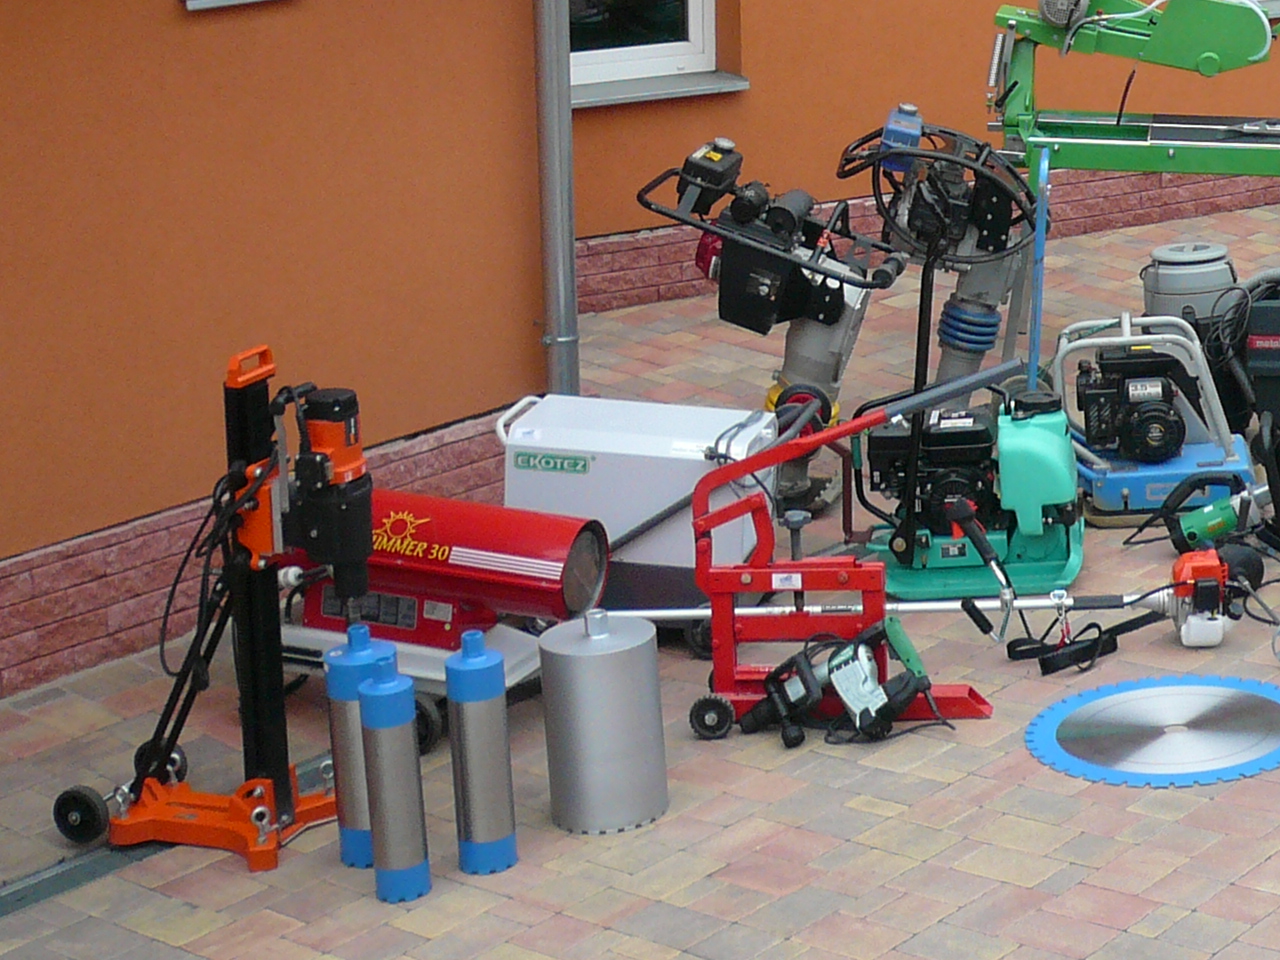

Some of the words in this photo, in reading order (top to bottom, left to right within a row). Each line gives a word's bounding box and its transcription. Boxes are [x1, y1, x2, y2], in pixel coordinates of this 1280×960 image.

[517, 453, 587, 471] EKOTEZ
[372, 533, 428, 558] IMMER
[427, 543, 450, 561] 30
